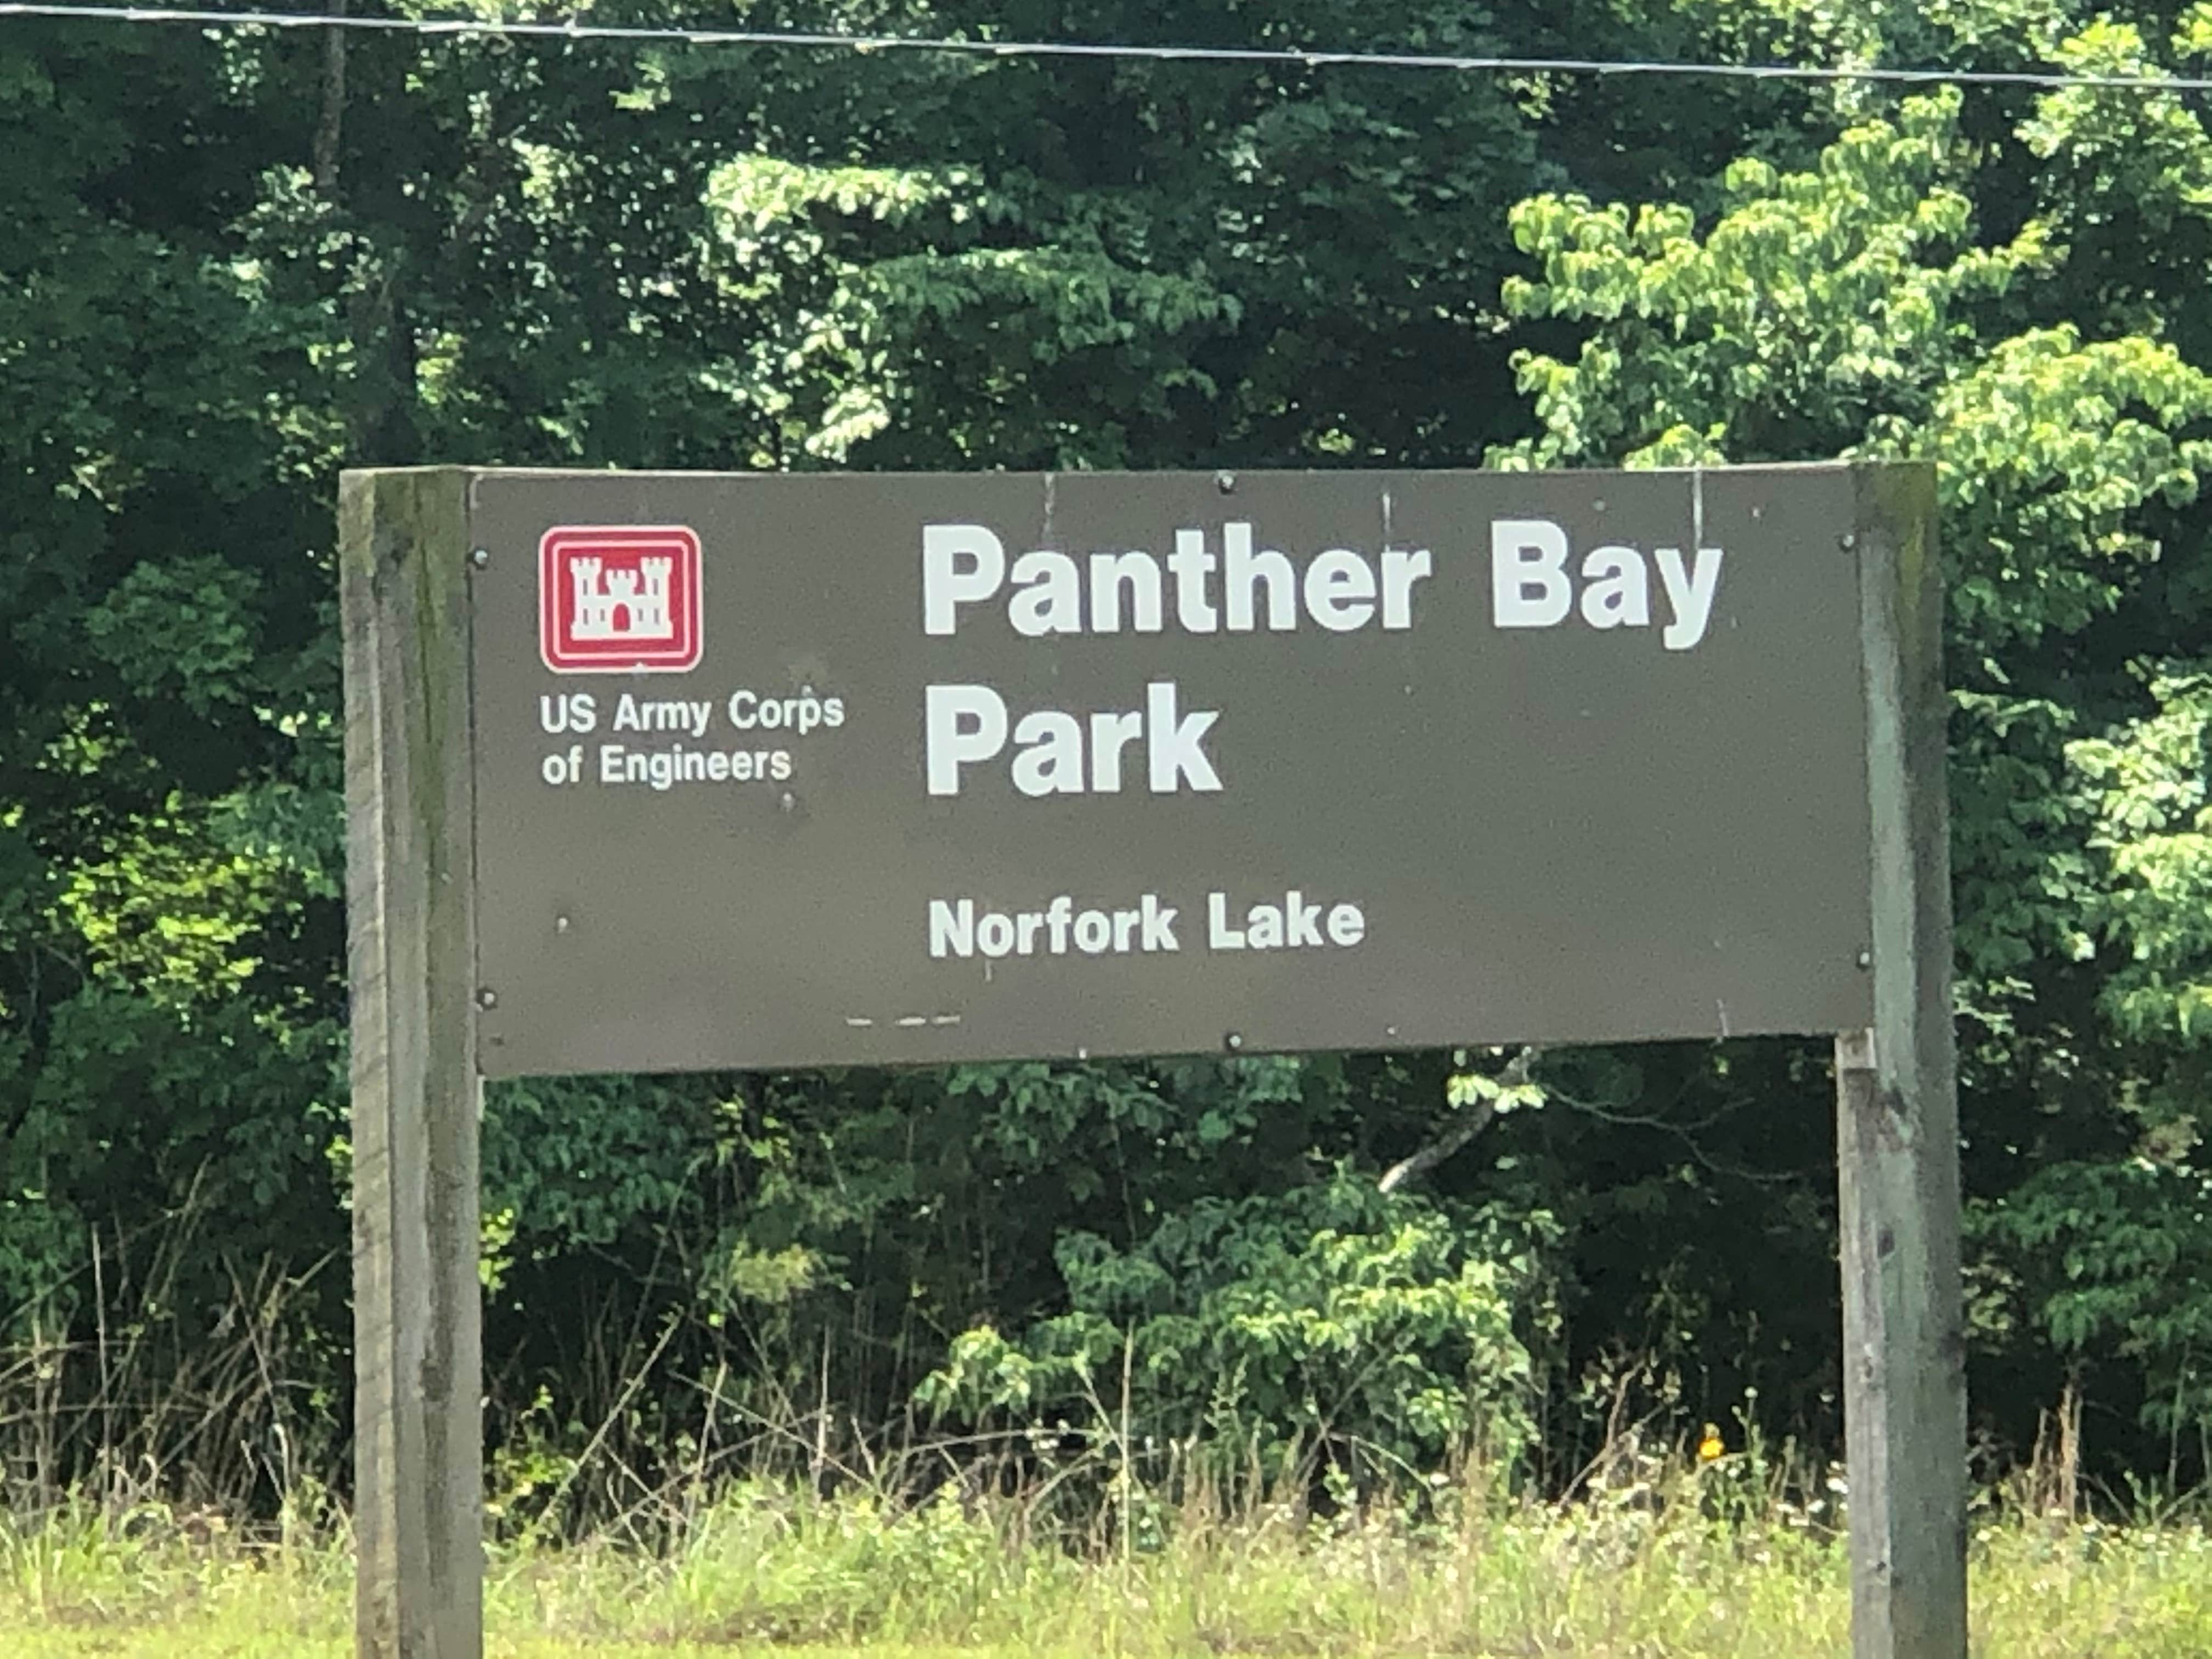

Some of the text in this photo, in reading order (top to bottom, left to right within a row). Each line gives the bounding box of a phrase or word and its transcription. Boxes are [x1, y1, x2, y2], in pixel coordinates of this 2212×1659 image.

[922, 519, 1724, 651] Panther Bay
[540, 690, 845, 737] US Army Corps
[925, 682, 1223, 797] Park
[542, 744, 792, 791] of Engineers
[928, 890, 1365, 958] Norfork Lake
